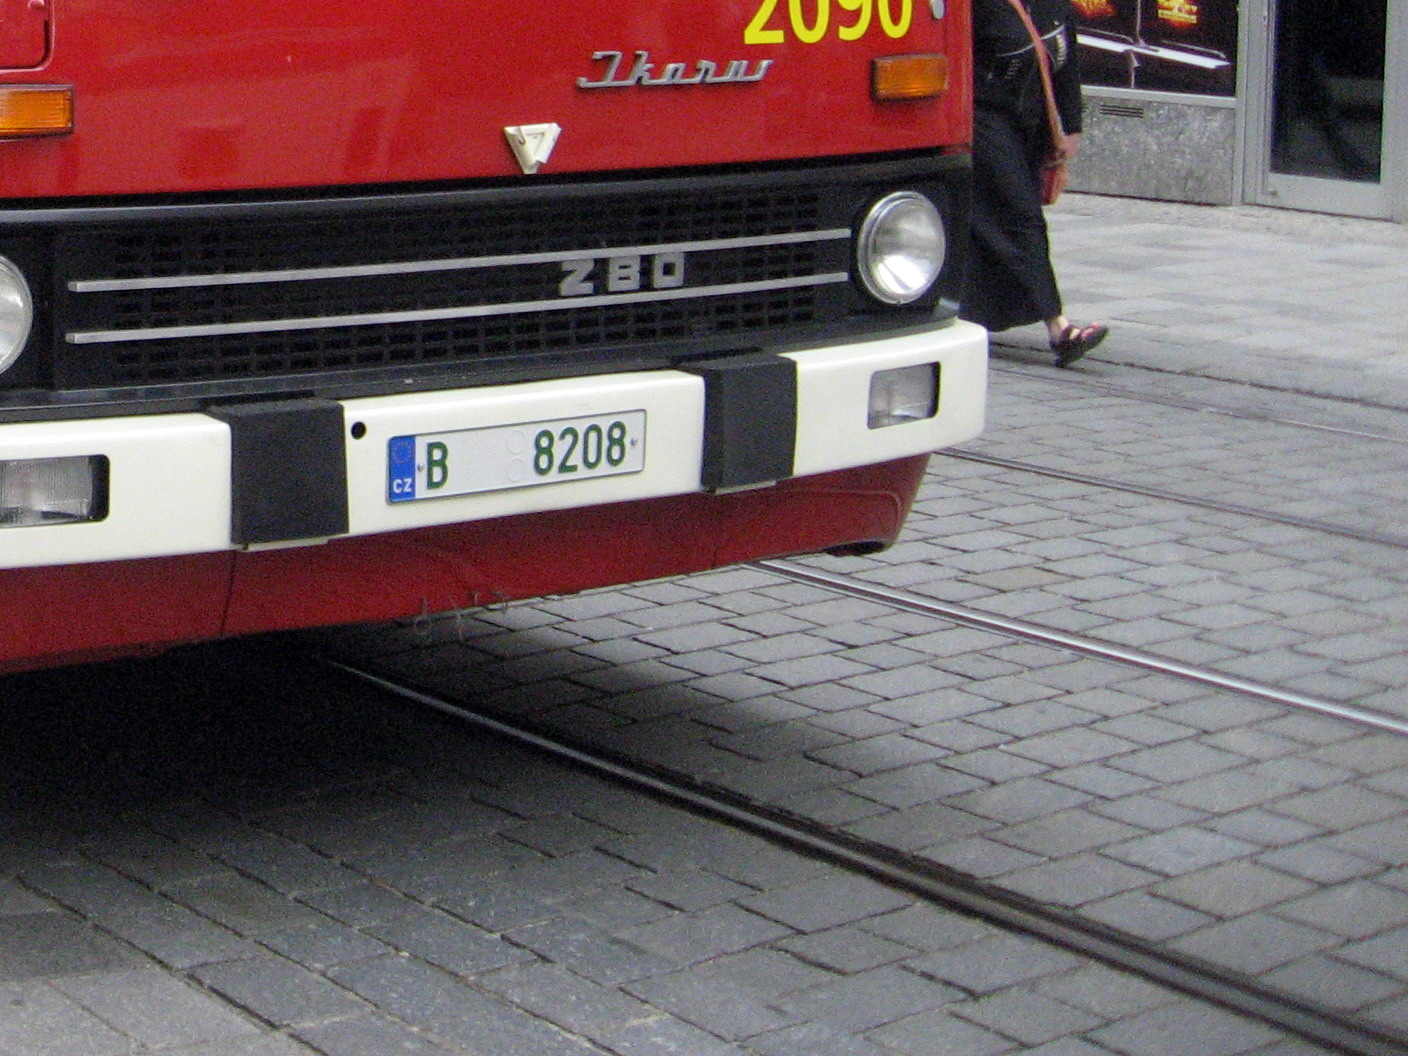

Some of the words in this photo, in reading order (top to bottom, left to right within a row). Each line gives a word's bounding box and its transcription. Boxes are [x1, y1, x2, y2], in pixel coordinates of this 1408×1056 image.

[576, 50, 774, 90] Ikarus
[559, 251, 686, 297] 280
[392, 478, 413, 494] CZ
[426, 440, 449, 490] B
[533, 420, 628, 477] 8208
